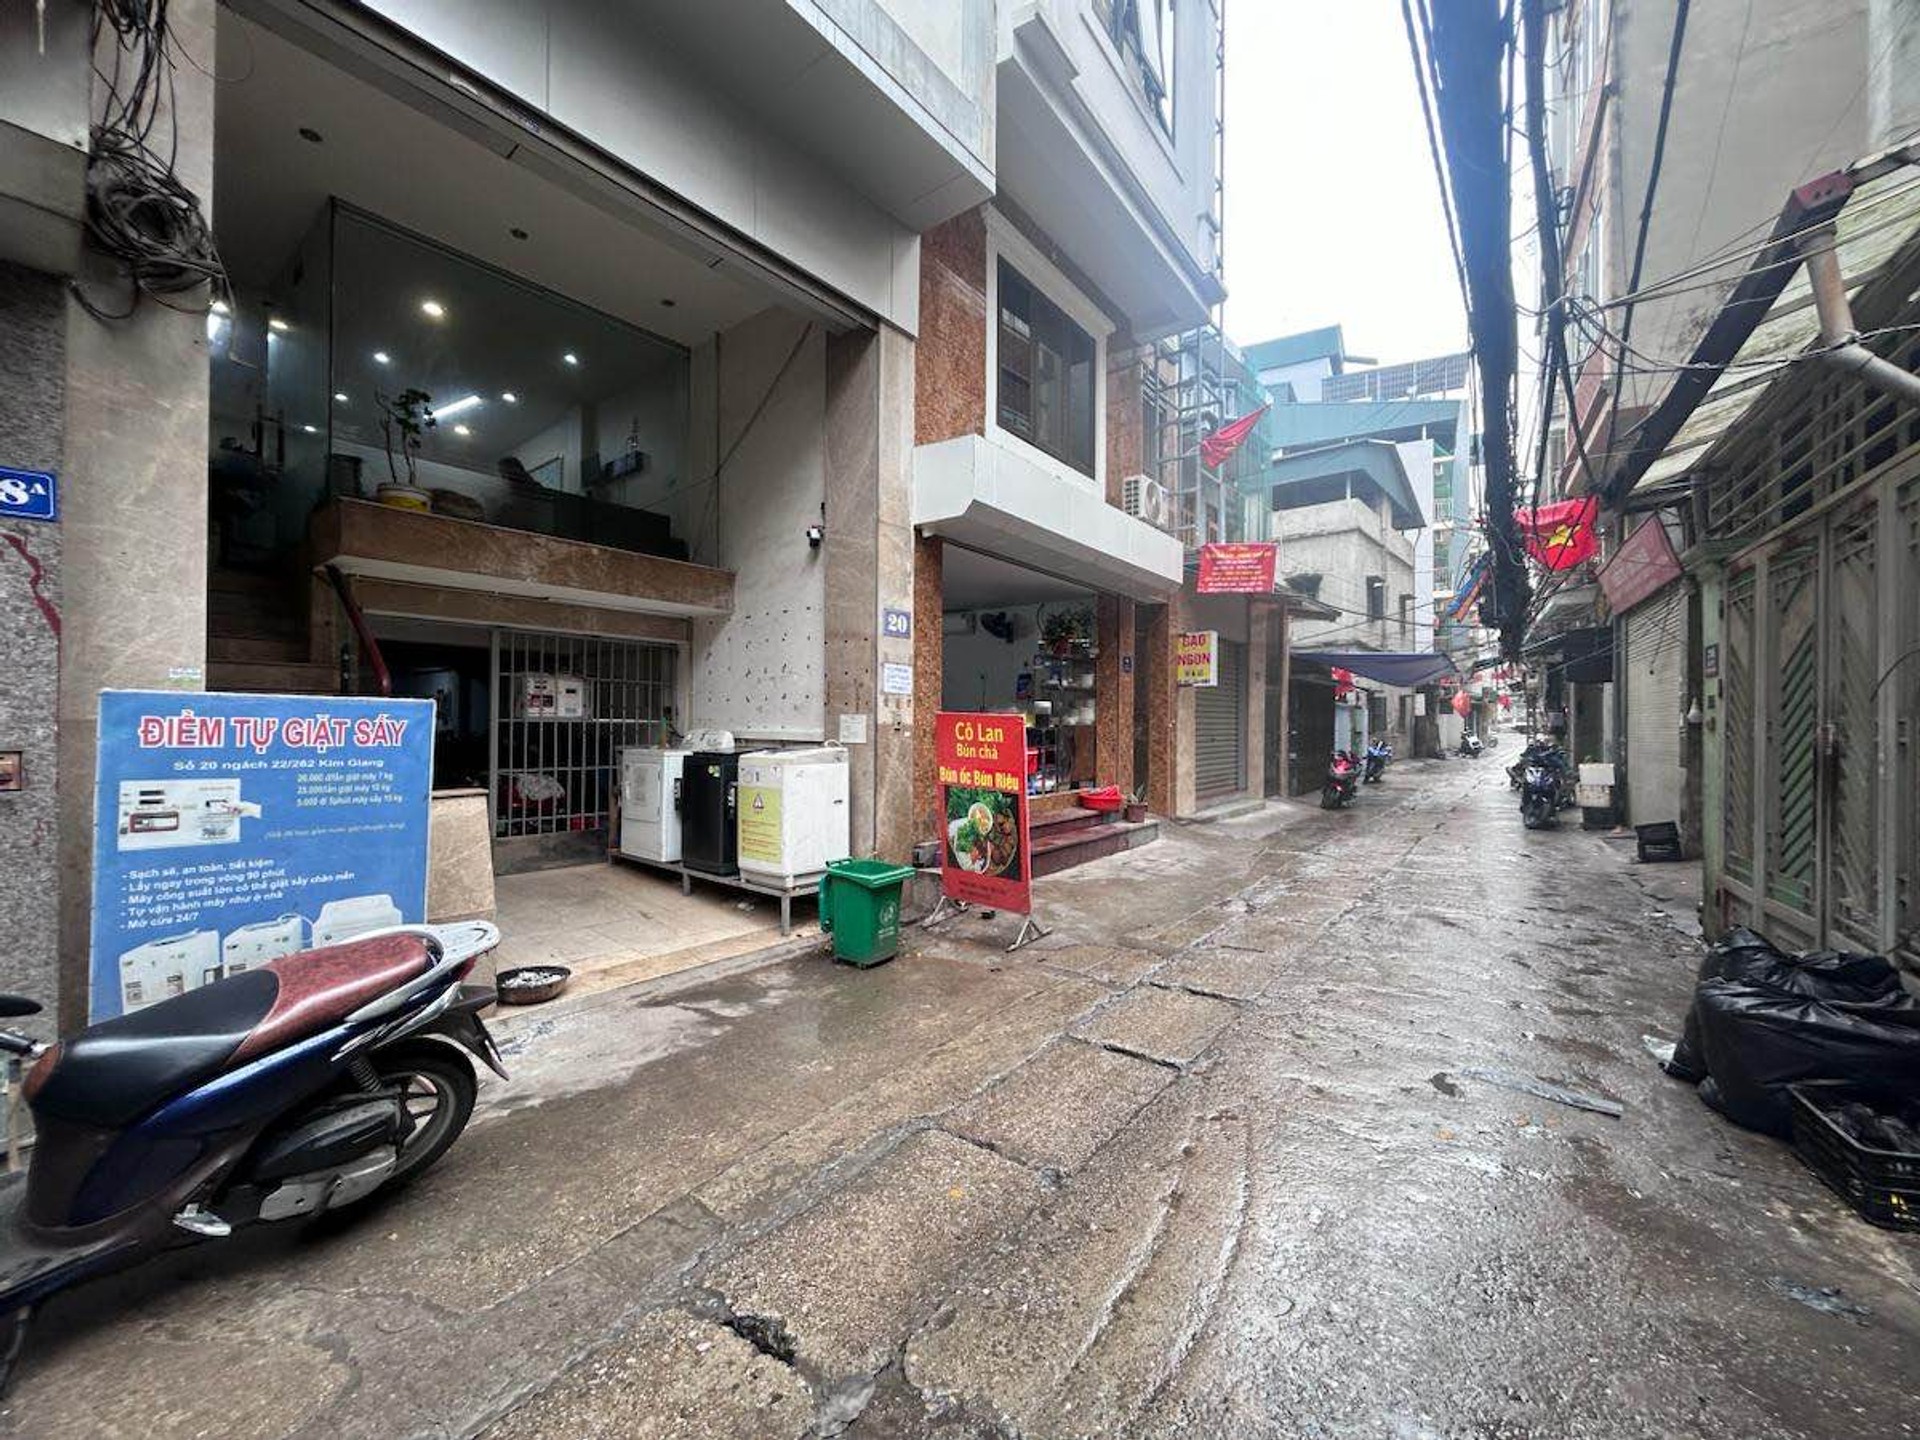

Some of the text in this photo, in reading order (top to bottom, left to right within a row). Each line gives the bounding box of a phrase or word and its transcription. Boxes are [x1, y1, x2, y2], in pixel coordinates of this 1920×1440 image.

[887, 613, 908, 633] 20
[230, 717, 279, 754] TỰ
[282, 714, 351, 753] GIẶT
[353, 713, 408, 747] SẤY
[955, 722, 1004, 743] Cô Lan
[956, 742, 976, 758] Bún
[200, 760, 218, 771] 20
[318, 759, 344, 769] Kim
[347, 759, 385, 769] Giang
[974, 769, 993, 787] Bún
[182, 866, 197, 875] an
[153, 880, 182, 891] ngay
[184, 876, 216, 886] trong
[176, 912, 201, 923] 24/7
